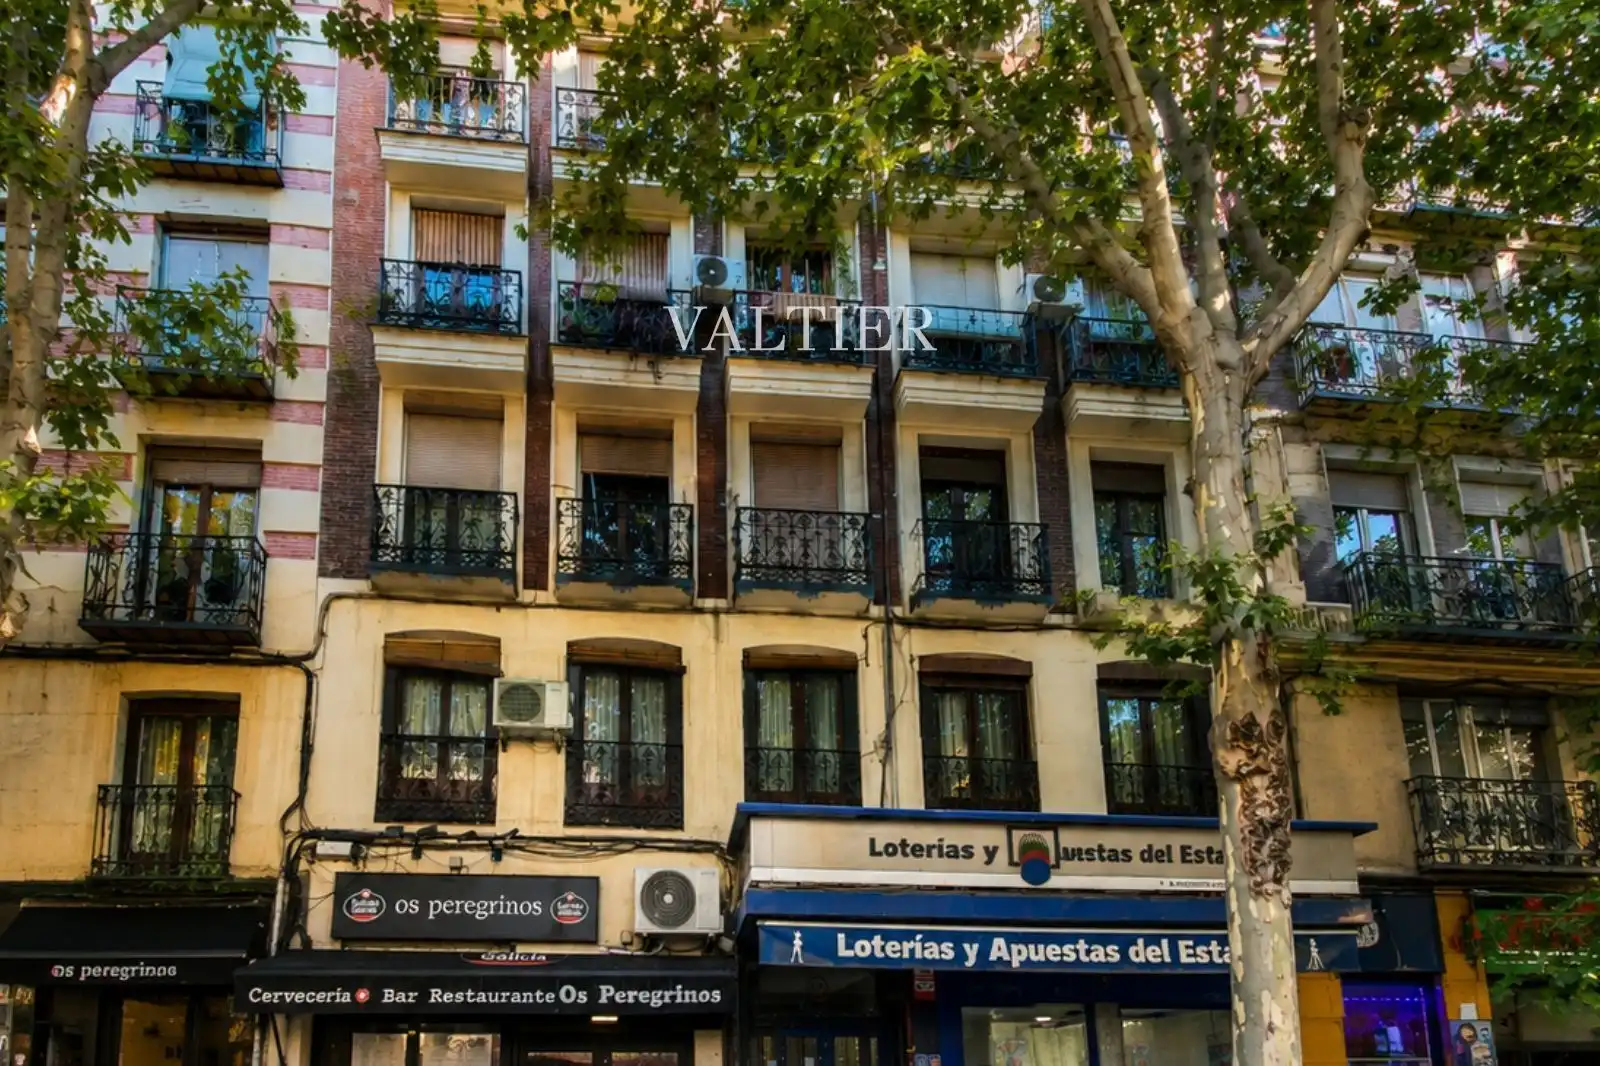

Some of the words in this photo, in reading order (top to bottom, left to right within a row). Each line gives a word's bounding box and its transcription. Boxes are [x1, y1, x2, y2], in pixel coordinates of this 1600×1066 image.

[982, 844, 1000, 866] y
[1140, 844, 1173, 863] del
[395, 898, 419, 914] os
[428, 894, 543, 921] peregrinos
[836, 932, 955, 960] Loterías
[962, 942, 980, 968] y
[988, 937, 1121, 969] Apuestas
[1128, 938, 1172, 964] del
[248, 986, 352, 1004] Cervecería
[381, 988, 419, 1004] Bar
[428, 986, 556, 1004] Restaurante
[558, 984, 588, 1005] Os
[597, 984, 723, 1007] Peregrinos
